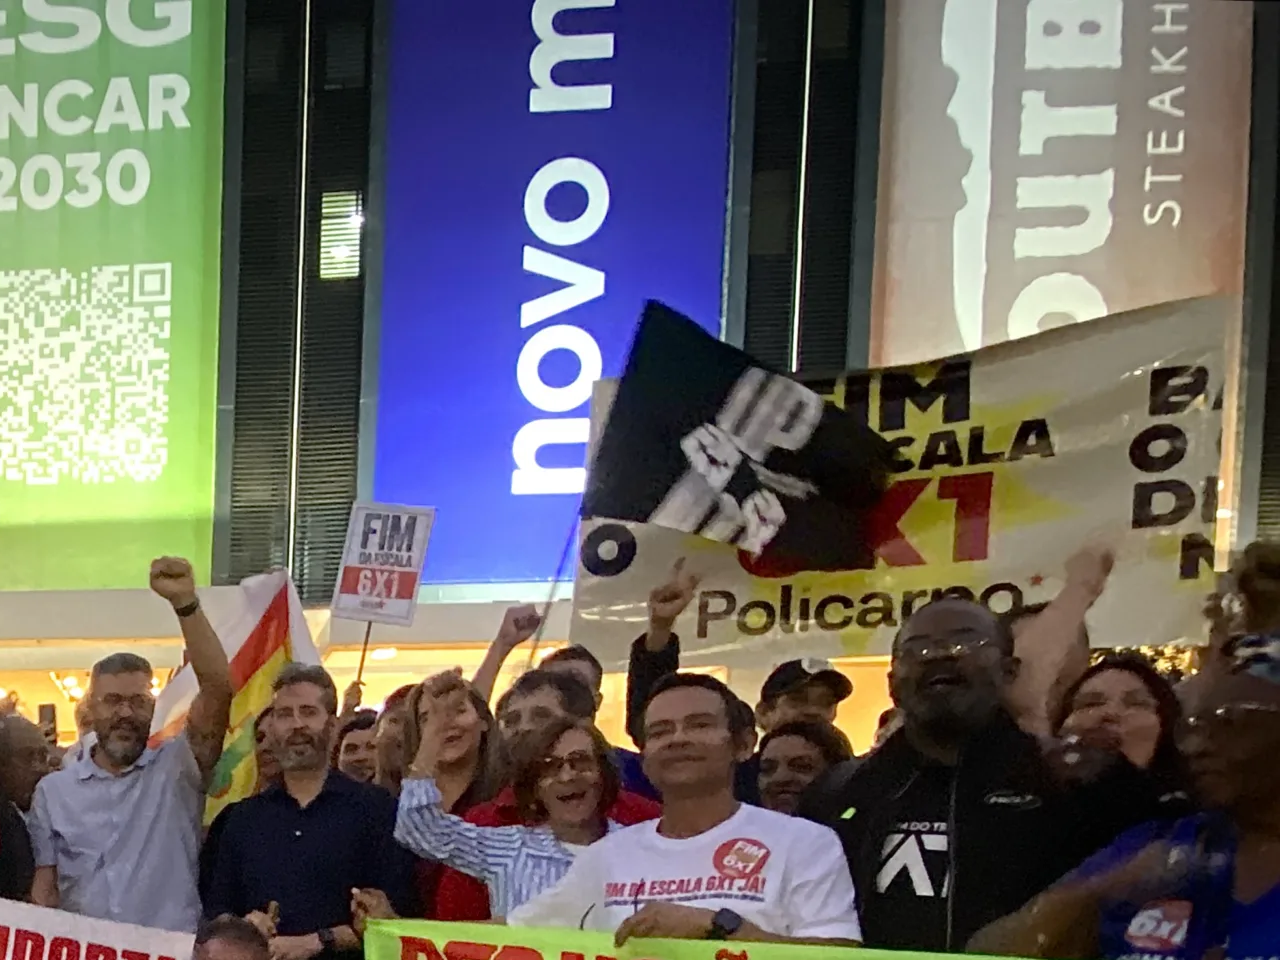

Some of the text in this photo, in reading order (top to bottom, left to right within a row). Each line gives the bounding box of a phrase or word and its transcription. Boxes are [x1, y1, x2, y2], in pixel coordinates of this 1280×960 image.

[1143, 0, 1190, 228] STEAKH
[510, 157, 611, 496] novo
[361, 512, 418, 552] FIM
[357, 569, 400, 599] 6X1
[647, 876, 703, 896] ESCALA
